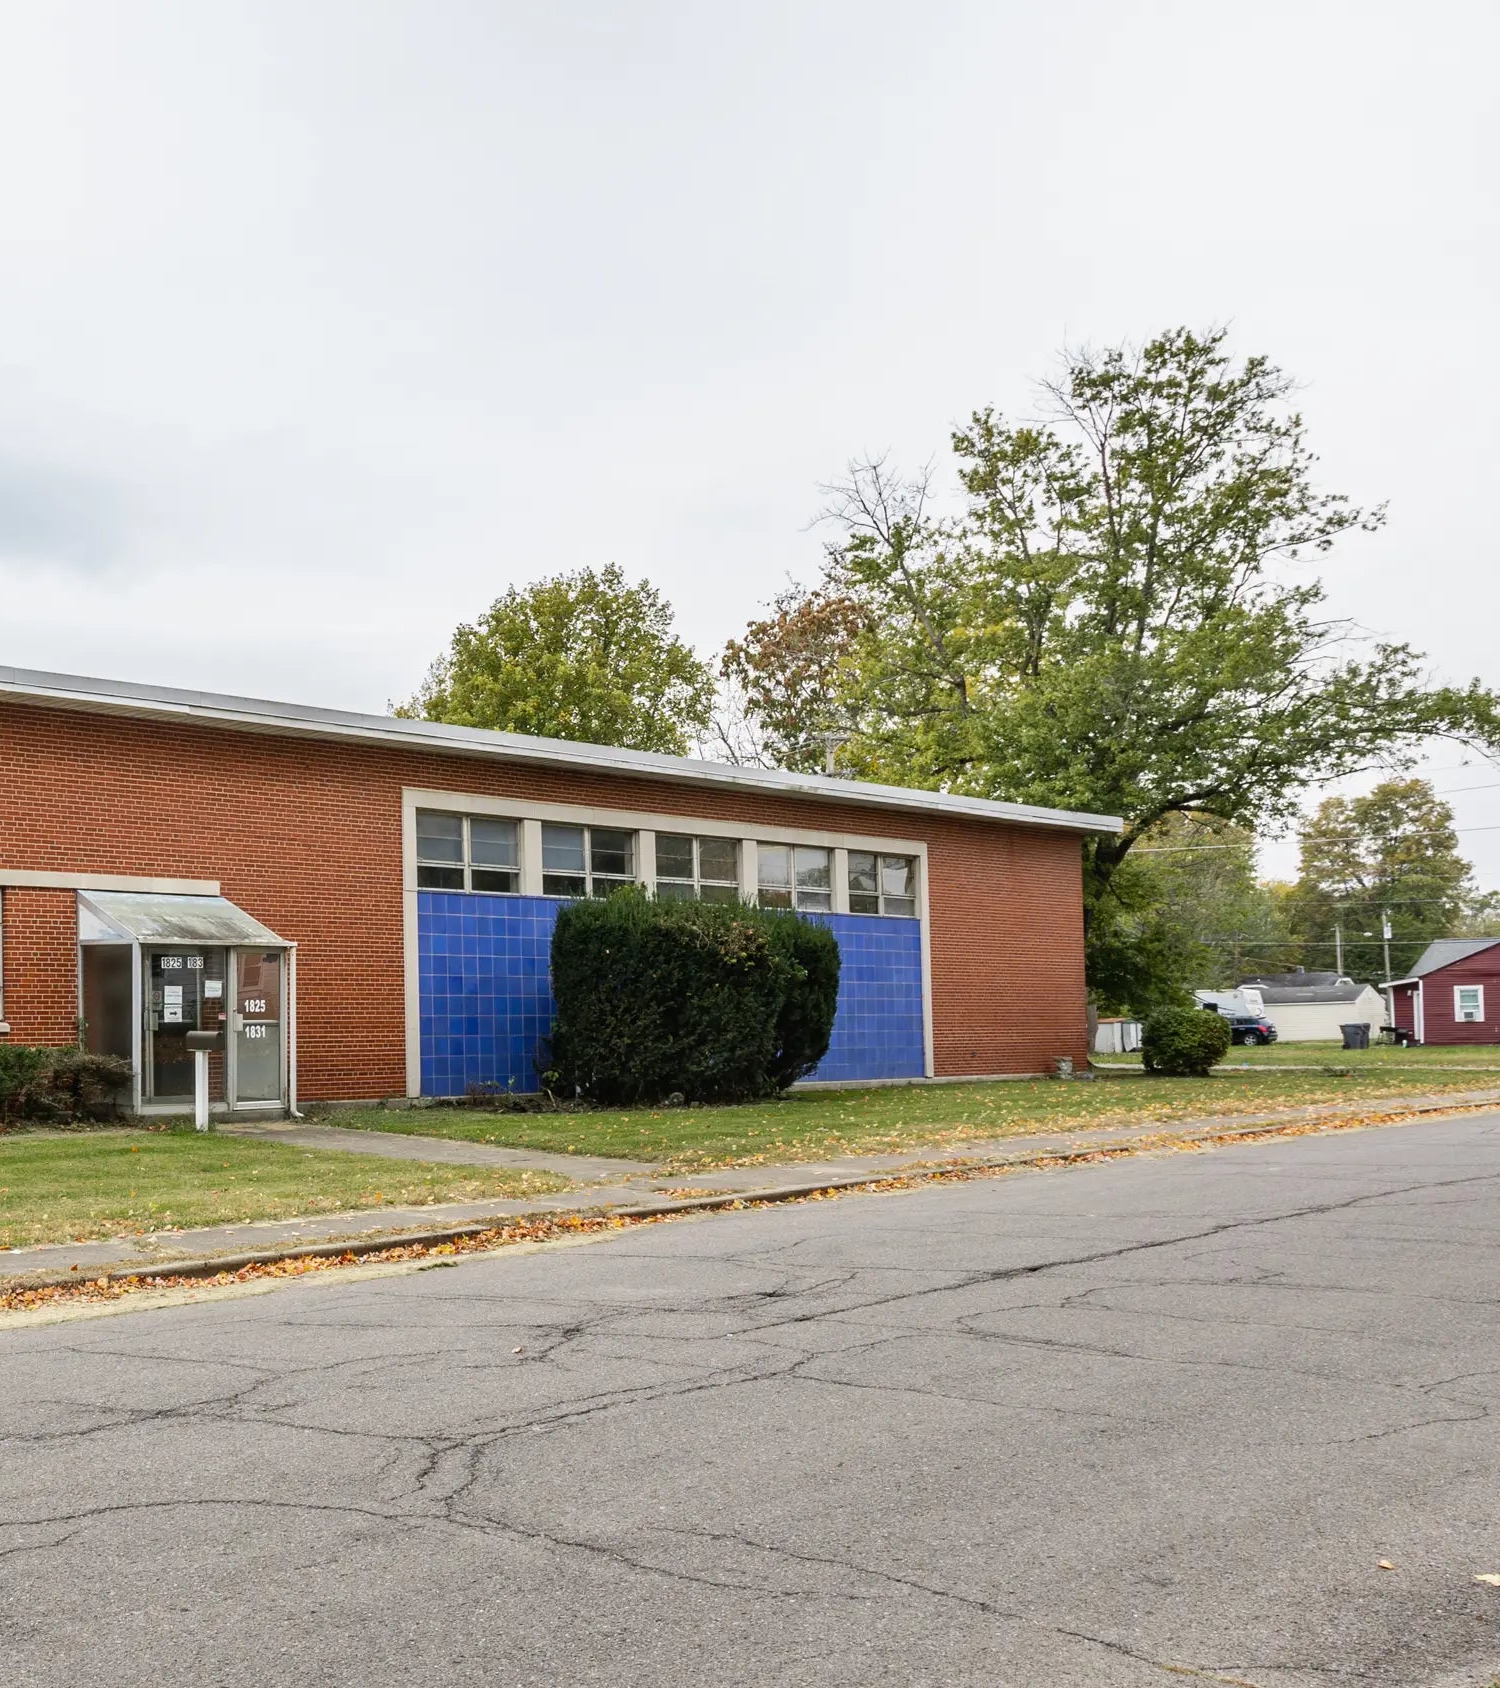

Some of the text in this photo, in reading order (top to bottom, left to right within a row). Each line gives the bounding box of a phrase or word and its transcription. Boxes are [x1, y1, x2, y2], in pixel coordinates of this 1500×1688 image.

[162, 957, 203, 968] 1825 183
[244, 1000, 266, 1012] 1825
[245, 1025, 266, 1038] 1831
